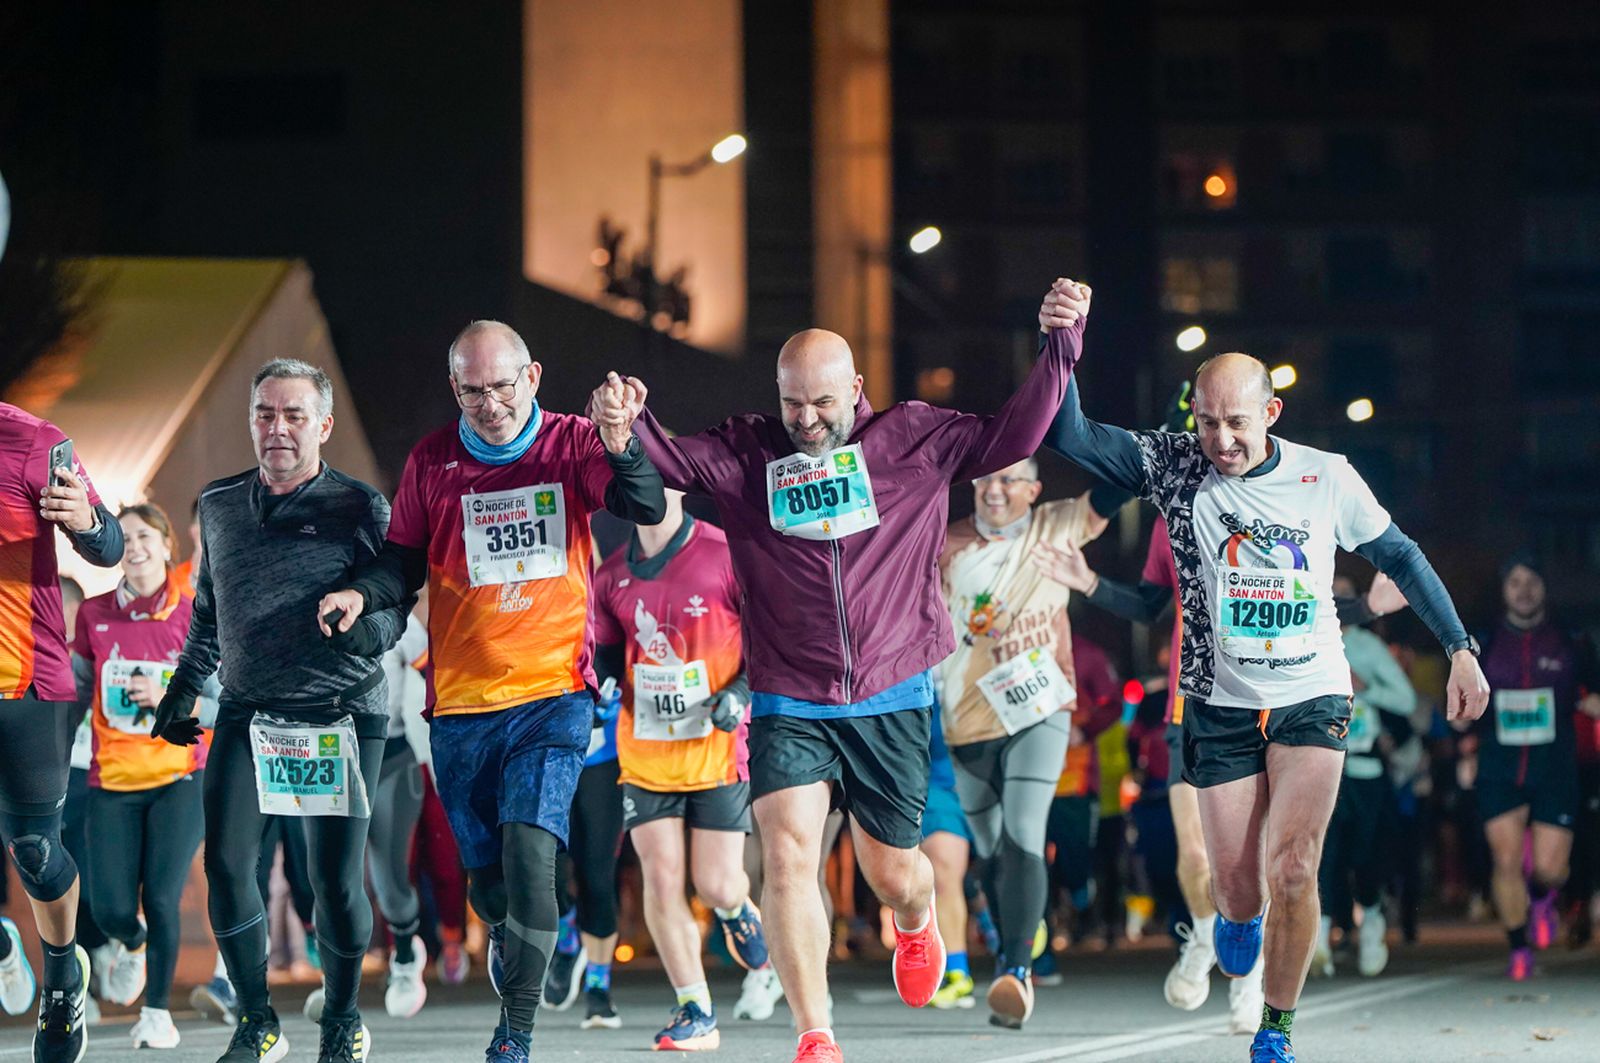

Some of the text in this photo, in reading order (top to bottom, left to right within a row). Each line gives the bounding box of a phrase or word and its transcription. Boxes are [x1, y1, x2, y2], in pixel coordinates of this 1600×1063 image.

[786, 462, 811, 475] NOCHE
[777, 476, 795, 489] SAN
[786, 477, 850, 515] 8057
[485, 500, 514, 512] NOCHE
[515, 498, 527, 509] DE
[475, 514, 495, 526] SAN
[486, 519, 547, 553] 3351
[490, 551, 525, 562] FRANCISCO
[1240, 578, 1285, 589] NOCHE DE
[1229, 588, 1249, 598] SAN
[1229, 601, 1309, 629] 12906
[647, 639, 668, 659] 43
[1005, 669, 1049, 705] 4066
[653, 693, 686, 715] 146
[269, 736, 310, 748] NOCHE DE
[261, 745, 278, 756] SAN
[265, 757, 335, 786] 12523
